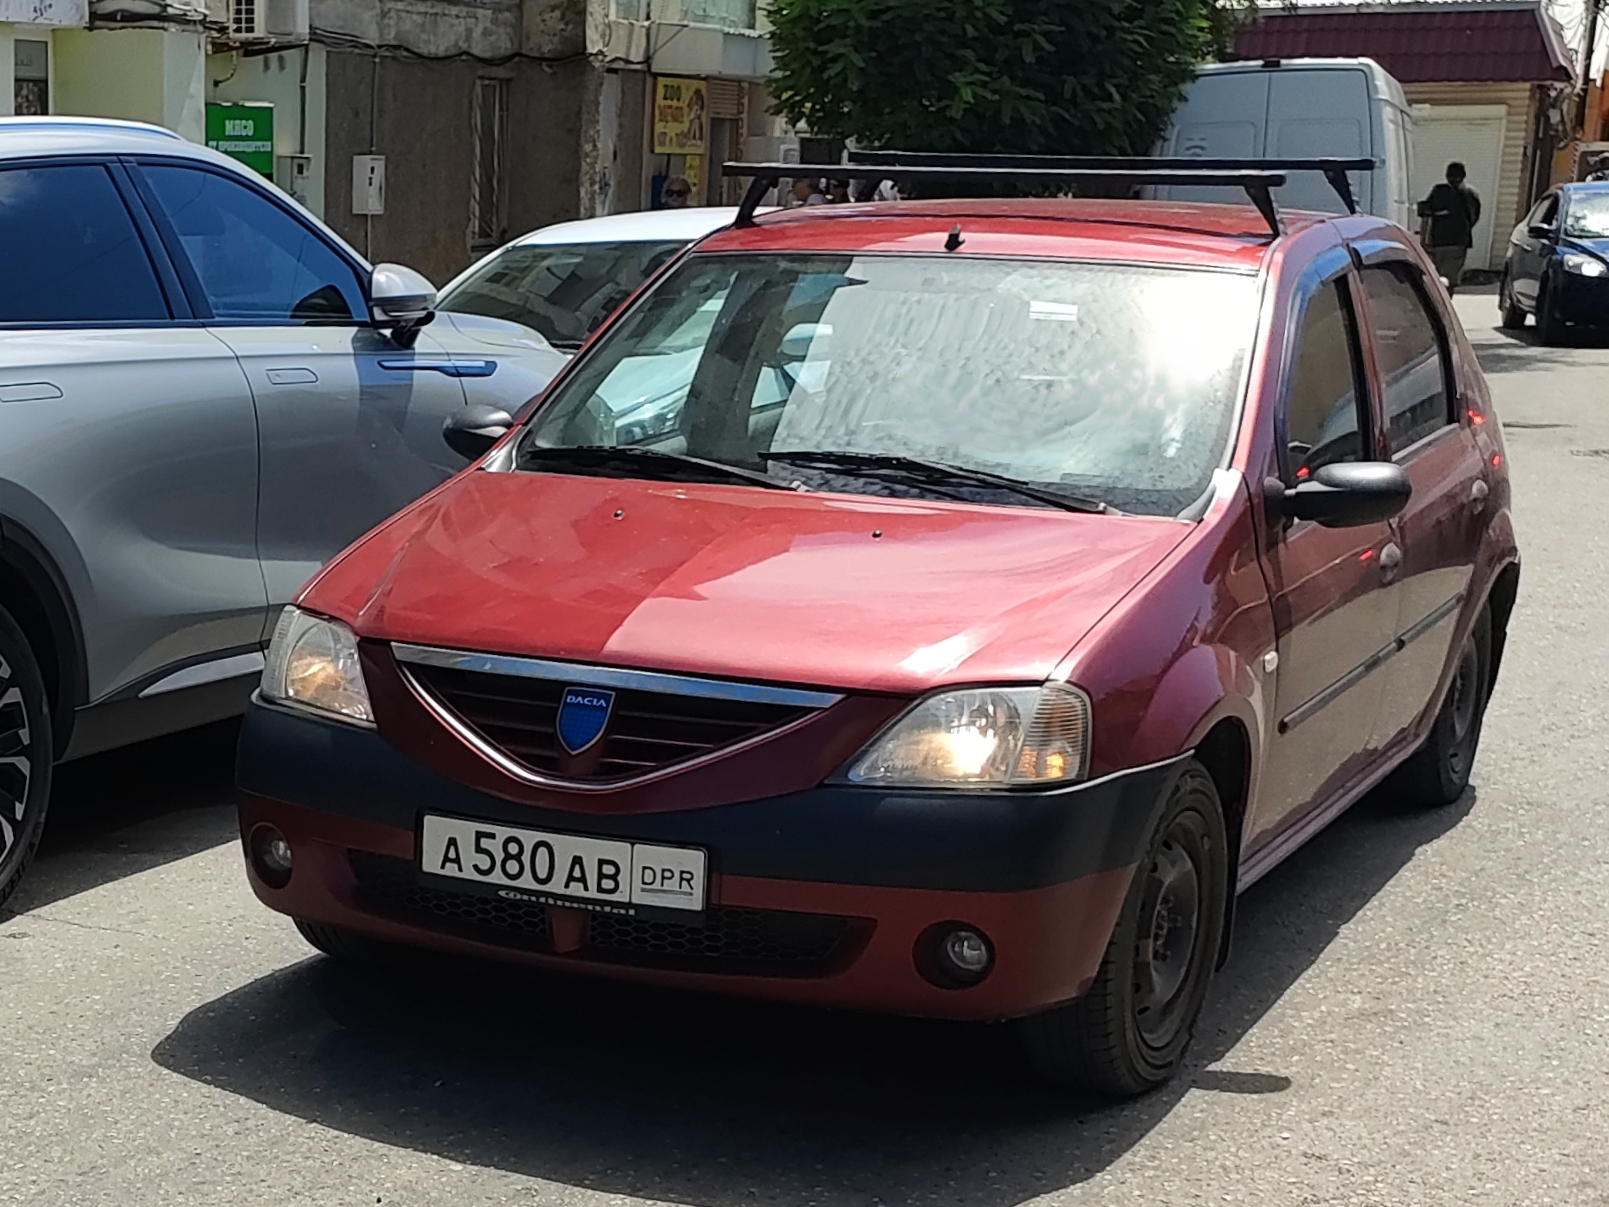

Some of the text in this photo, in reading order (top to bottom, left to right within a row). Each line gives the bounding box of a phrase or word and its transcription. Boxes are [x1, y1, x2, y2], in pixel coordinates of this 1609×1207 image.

[663, 84, 682, 102] ZOO
[225, 119, 254, 136] МЯСО
[566, 695, 607, 707] DACIA
[641, 866, 695, 891] DPR
